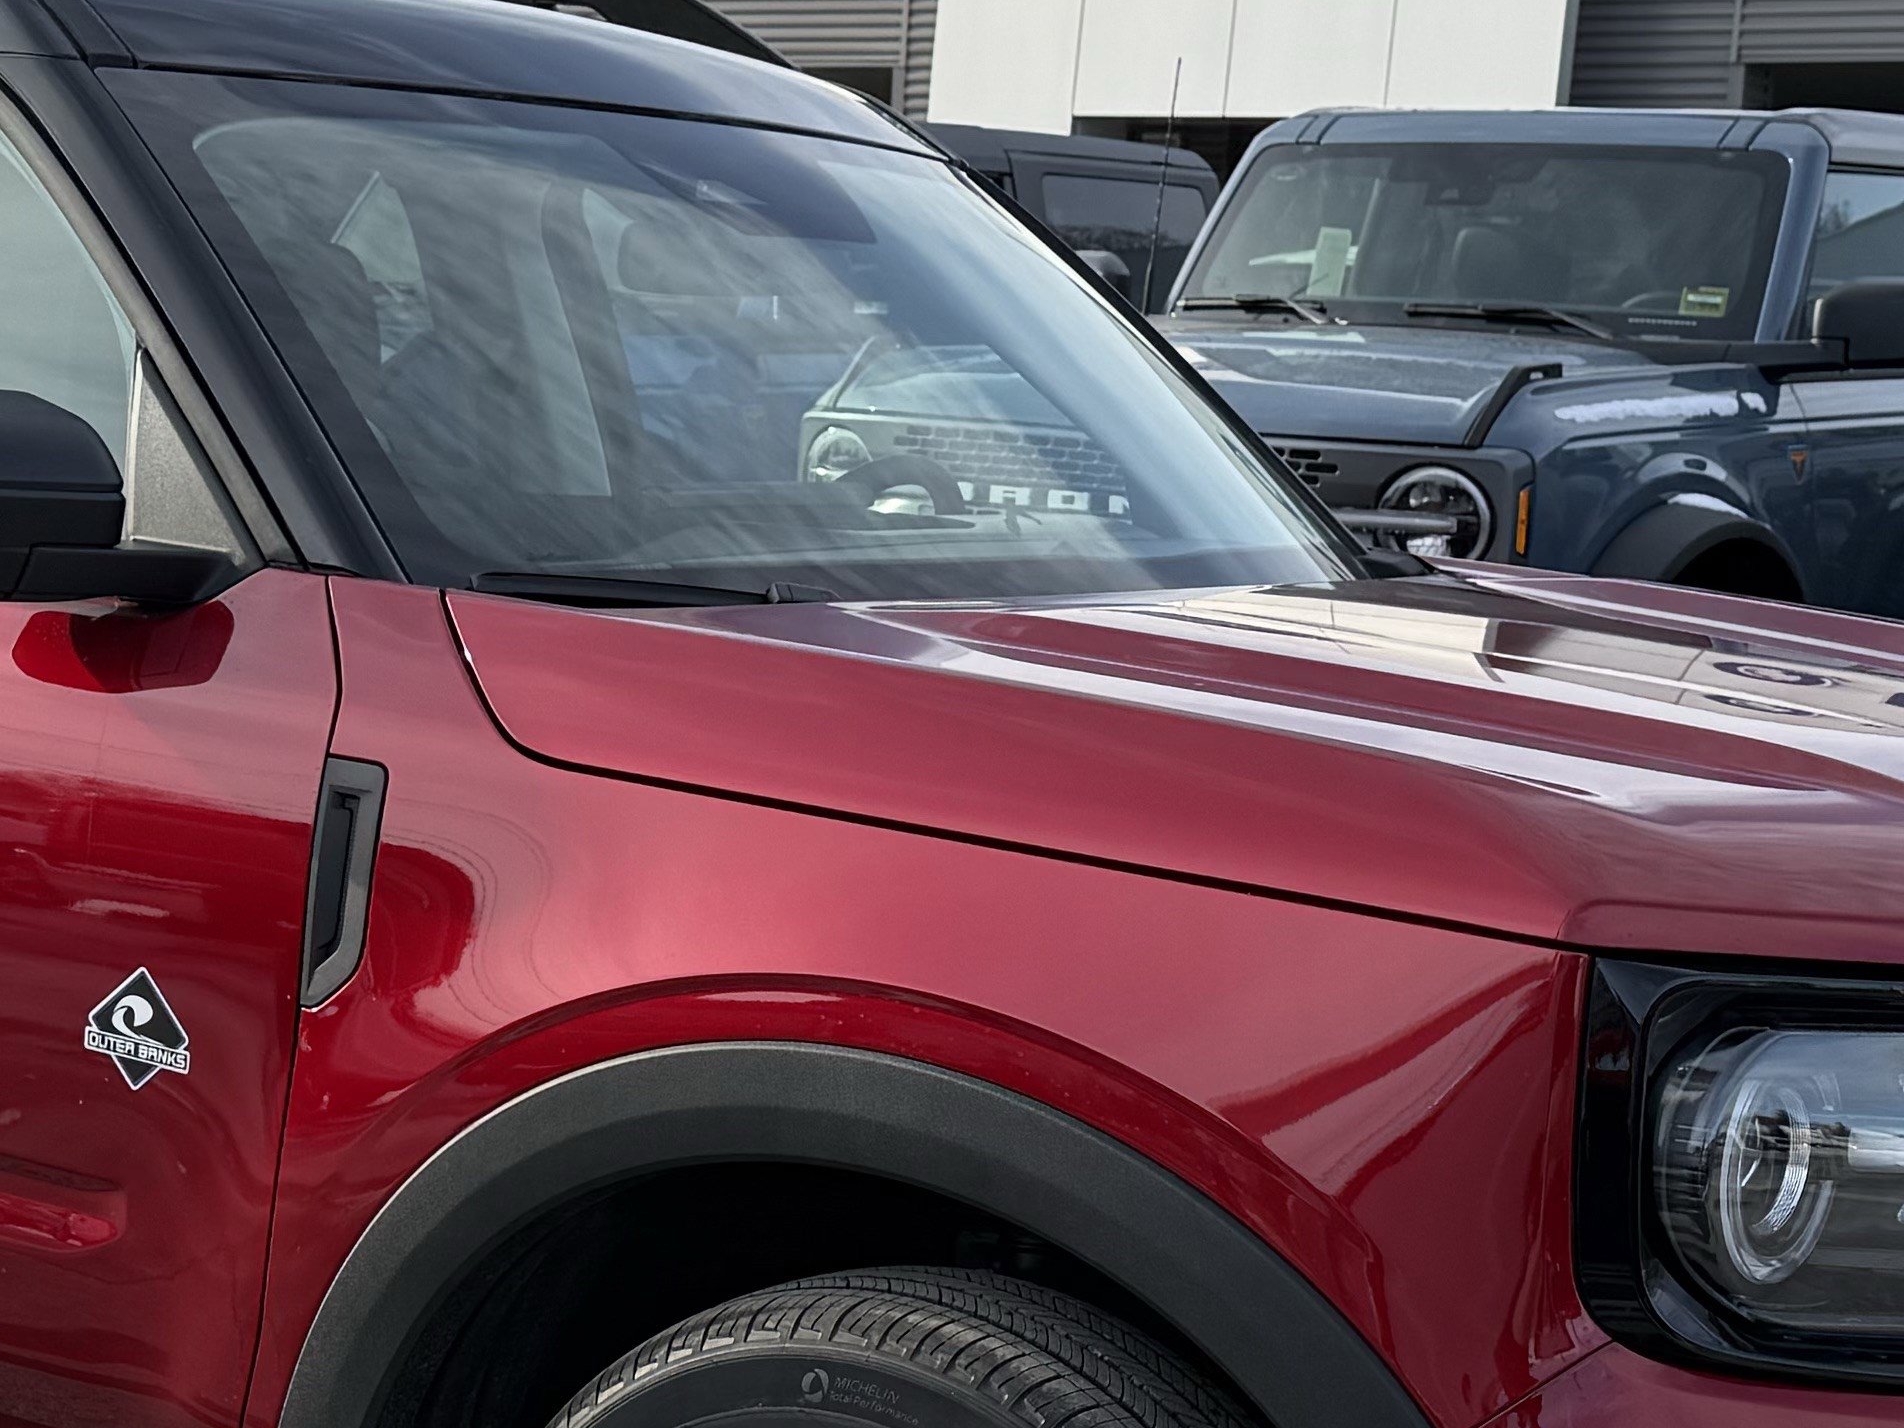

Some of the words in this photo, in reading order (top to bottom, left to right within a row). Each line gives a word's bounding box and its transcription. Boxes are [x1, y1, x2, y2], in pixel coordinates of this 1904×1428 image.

[89, 1032, 135, 1055] OUTER
[138, 1045, 186, 1069] BANKS
[834, 1377, 901, 1404] MICHELIN
[829, 1391, 853, 1404] Total
[853, 1396, 920, 1426] Performance
